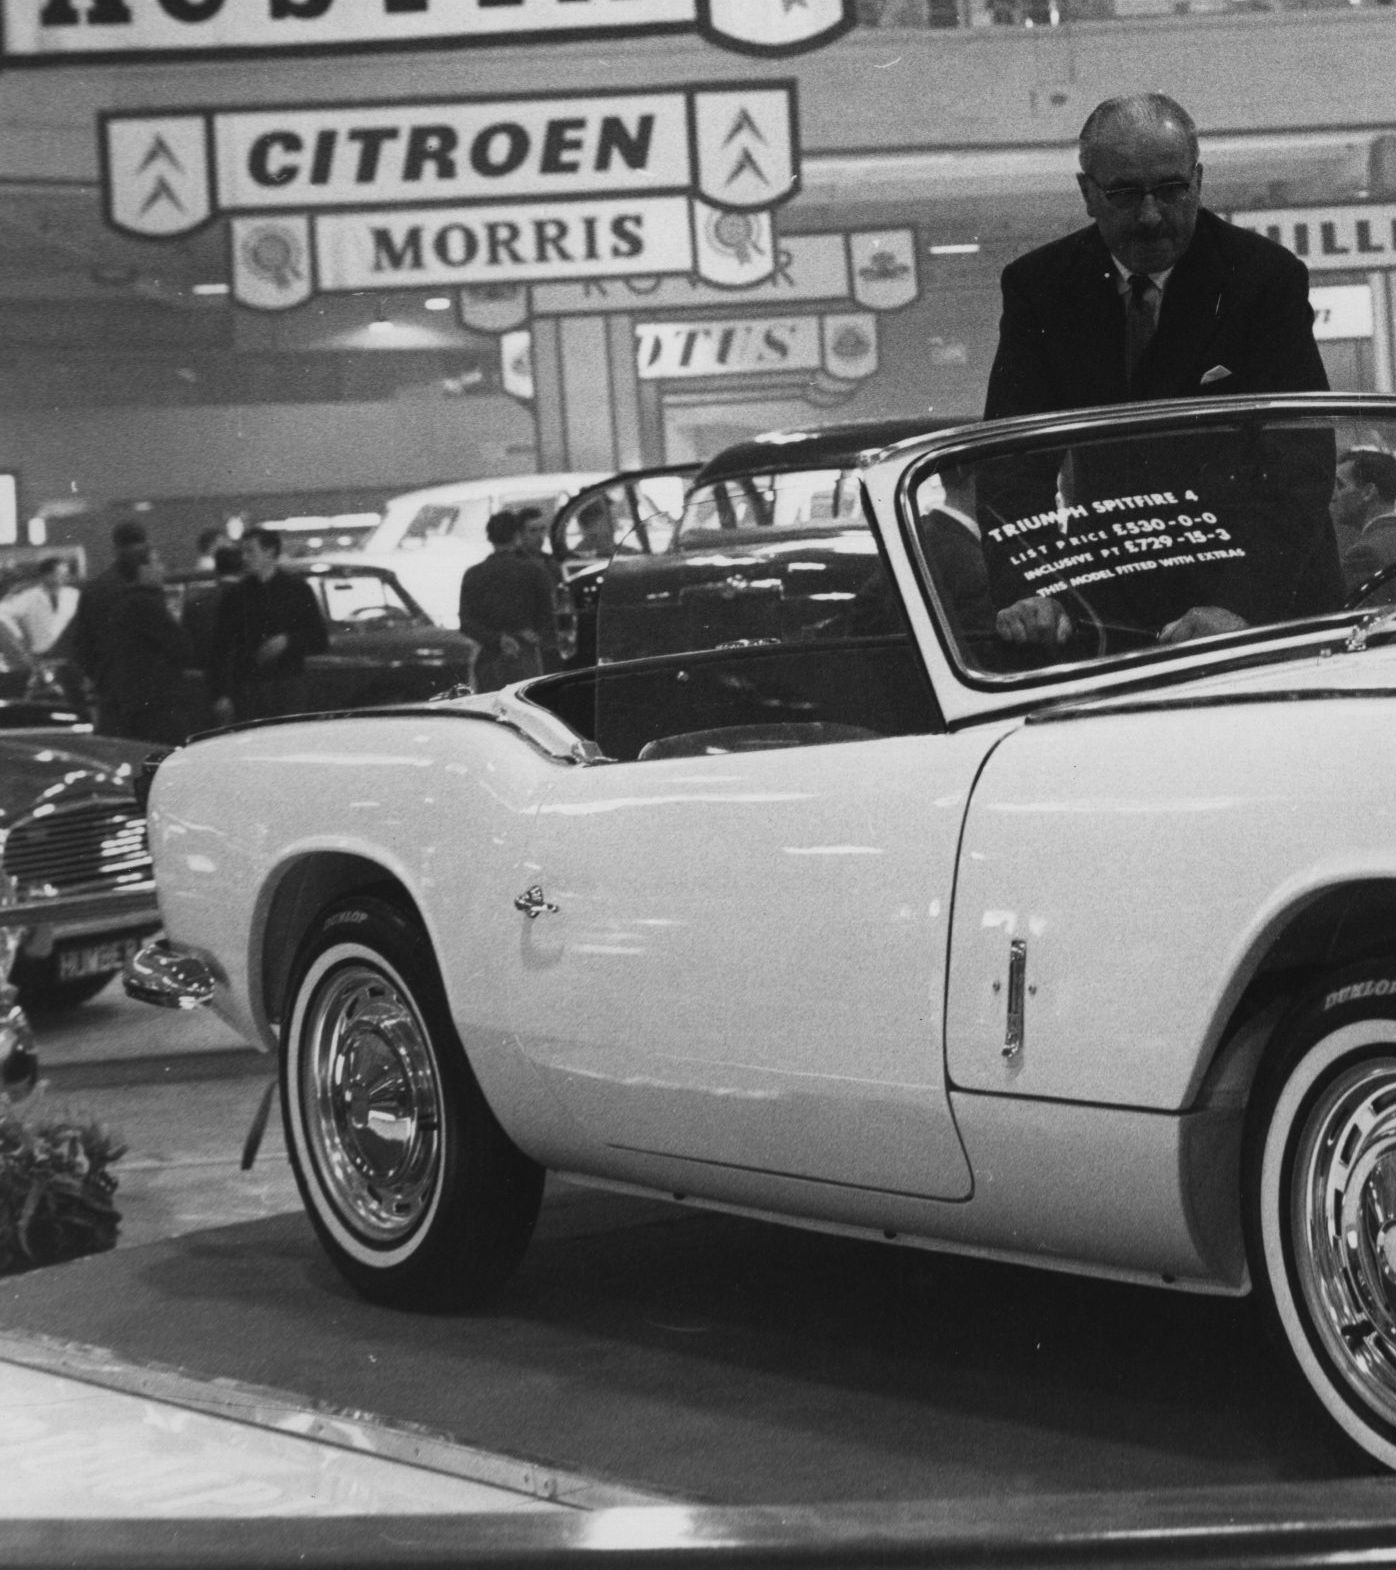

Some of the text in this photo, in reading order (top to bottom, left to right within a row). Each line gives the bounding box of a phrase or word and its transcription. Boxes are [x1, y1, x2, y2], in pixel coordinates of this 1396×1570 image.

[247, 114, 656, 187] CITROEN
[370, 214, 644, 272] MORRIS
[988, 489, 1199, 542] TRIUMPH SPITFIRE 4
[1010, 545, 1048, 565] LIST
[1056, 530, 1108, 549] PRICE
[1024, 552, 1094, 581] INCLUSIVE
[1036, 548, 1246, 598] THIS MODEL FITTED WITH EXTRAS
